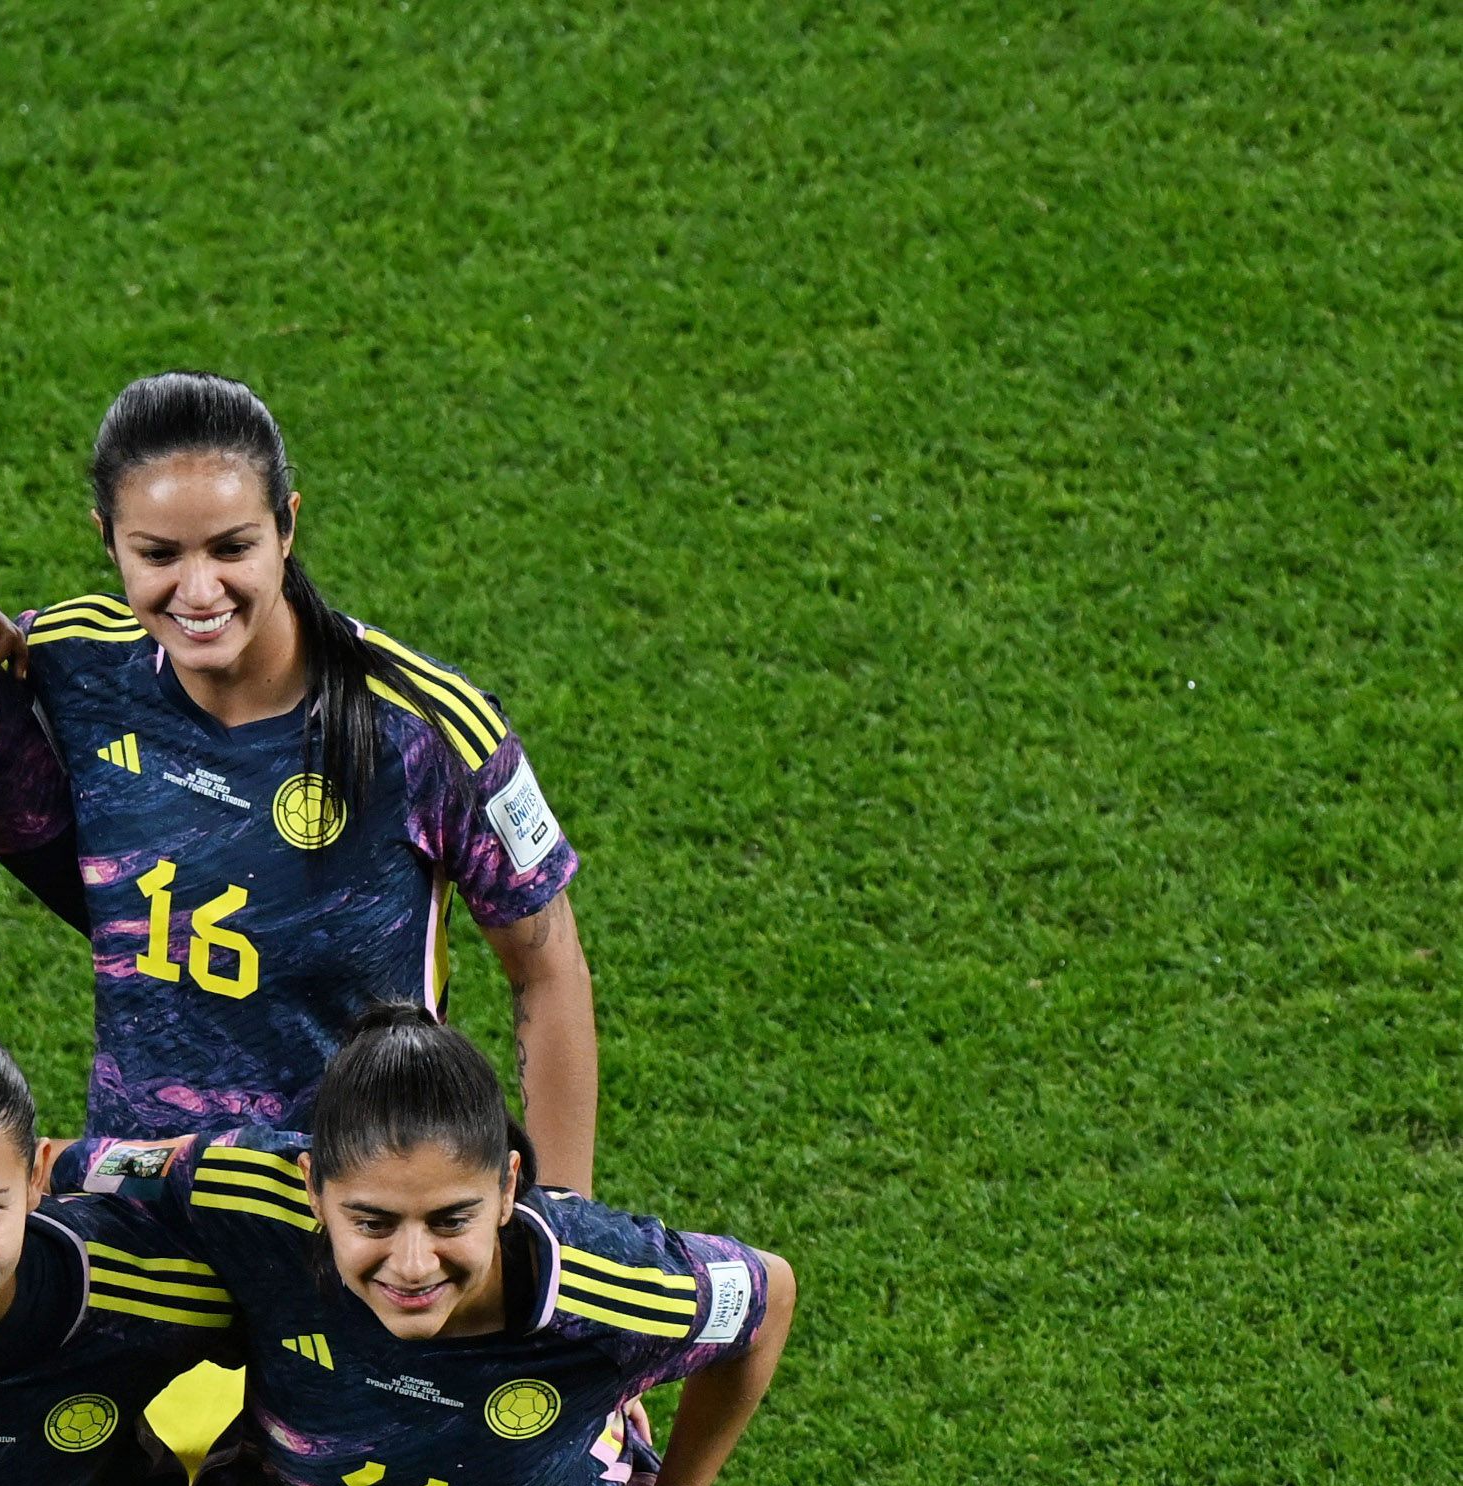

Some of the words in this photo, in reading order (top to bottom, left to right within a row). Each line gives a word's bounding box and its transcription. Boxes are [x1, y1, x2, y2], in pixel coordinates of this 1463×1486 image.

[186, 772, 196, 782] 30
[196, 777, 213, 788] JULY
[213, 782, 230, 794] 2023
[195, 768, 226, 784] GERMANY
[188, 782, 220, 799] FOOTBALL
[221, 794, 251, 810] STADIUM
[136, 859, 259, 999] 16
[392, 1378, 401, 1386] 30
[402, 1382, 420, 1391] JULY
[421, 1386, 440, 1396] 2023
[400, 1374, 434, 1388] GERMANY
[366, 1378, 393, 1391] SYDNEY
[394, 1387, 430, 1400] FOOTBALL
[432, 1396, 464, 1408] STADIUM
